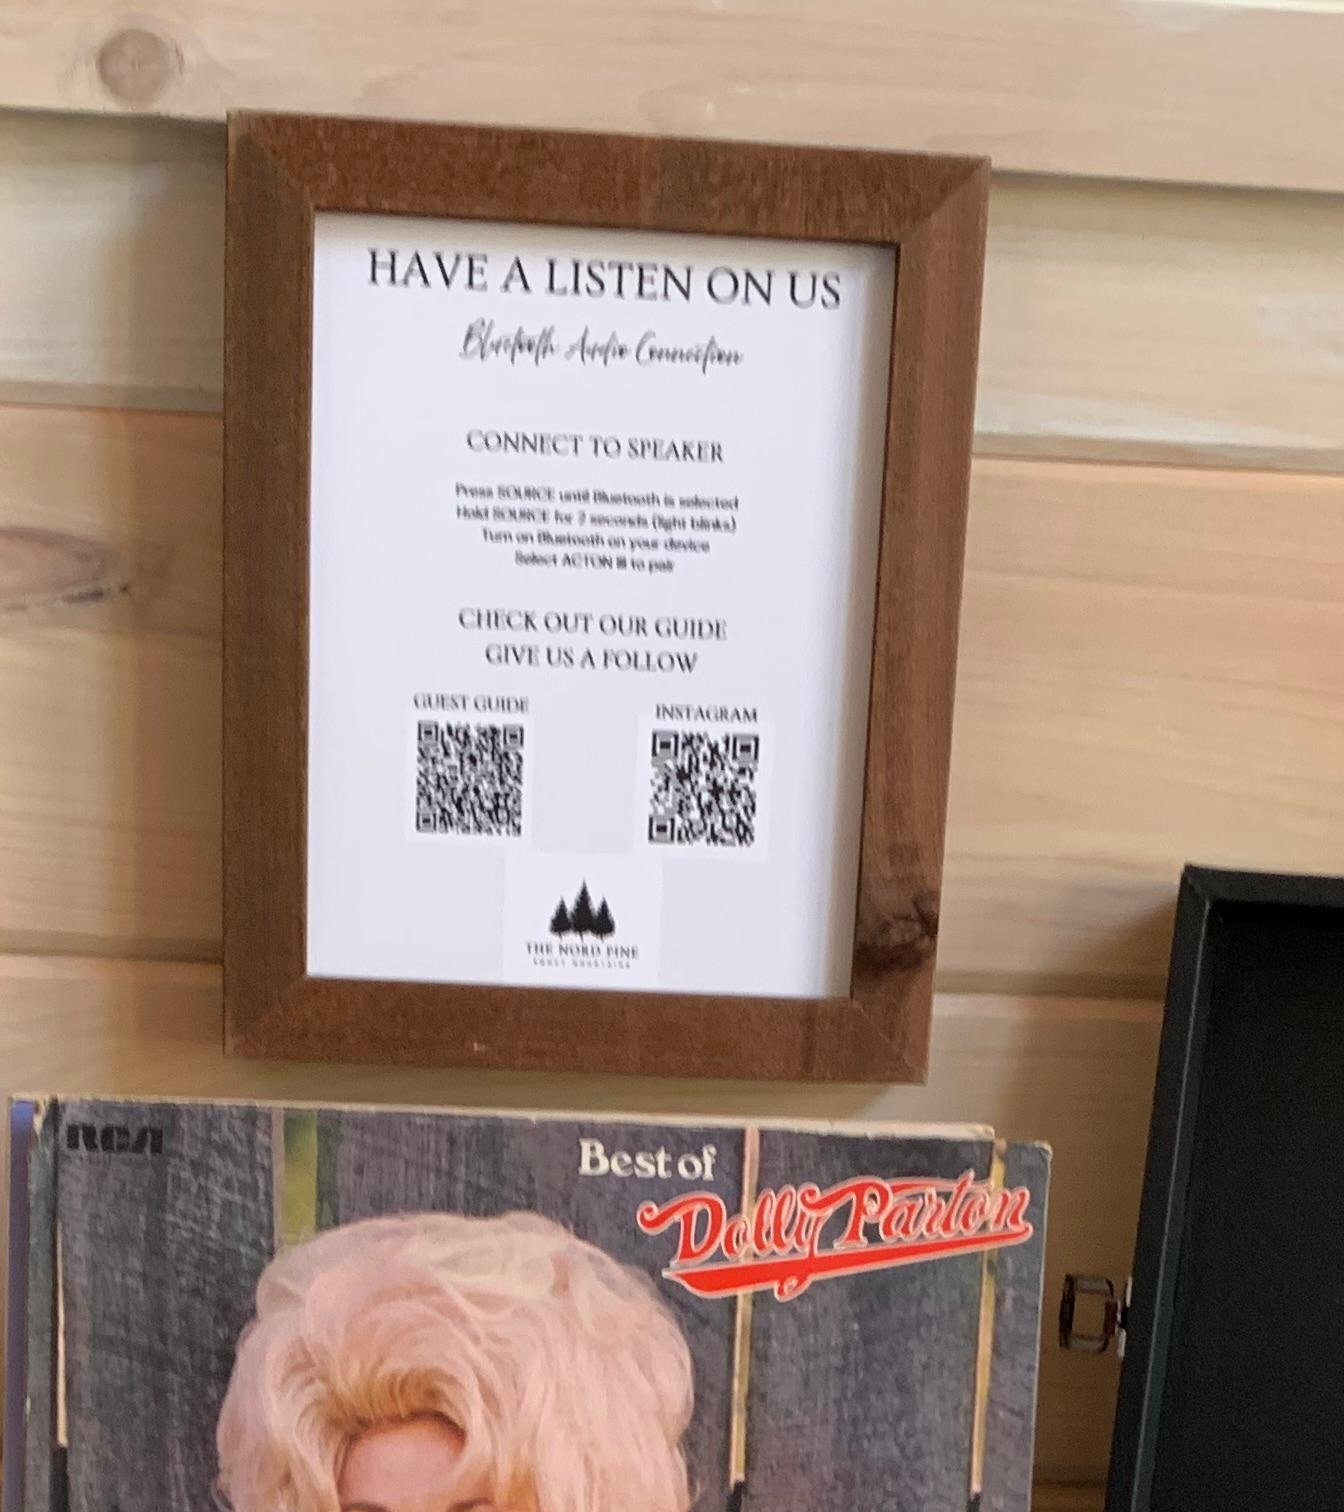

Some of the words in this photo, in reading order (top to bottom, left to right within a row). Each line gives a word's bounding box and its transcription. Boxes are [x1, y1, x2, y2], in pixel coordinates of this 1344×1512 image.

[367, 247, 488, 291] HAVE
[499, 255, 531, 293] A
[544, 256, 692, 302] LISTEN
[706, 265, 773, 306] ON
[788, 270, 842, 310] US
[458, 316, 556, 368] Bluetooth
[563, 324, 632, 367] Audio
[635, 328, 743, 376] Connection
[466, 427, 583, 457] CONNECT
[588, 433, 621, 459] TO
[627, 436, 724, 464] SPEAKER
[455, 481, 494, 499] Press
[497, 484, 554, 502] SOURCE
[559, 487, 590, 503] until
[593, 488, 660, 507] Bluetooth
[663, 492, 675, 508] is
[679, 493, 739, 511] selected
[456, 504, 489, 520] Hold
[493, 506, 550, 524] SOURCE
[554, 509, 572, 525] for
[590, 513, 648, 529] seconds
[652, 513, 686, 533] (light
[690, 515, 736, 534] blinks)
[483, 527, 513, 543] Turn
[515, 531, 534, 544] on
[537, 529, 605, 548] Bluetooth
[607, 535, 626, 550] on
[629, 537, 659, 552] your
[663, 537, 710, 553] device
[514, 549, 557, 567] Select
[562, 552, 613, 570] ACTON
[630, 557, 645, 572] to
[647, 556, 674, 575] pair
[458, 606, 538, 633] CHECK
[544, 610, 594, 636] OUT
[599, 612, 649, 638] OUR
[655, 616, 727, 641] GUIDE
[485, 643, 540, 668] GIVE
[546, 646, 575, 669] US
[579, 648, 597, 671] A
[602, 649, 699, 674] FOLLOW
[413, 691, 470, 713] GUEST
[473, 694, 530, 715] GUIDE
[655, 702, 759, 725] INSTAGRAM
[526, 941, 554, 956] THE
[558, 942, 602, 958] NORD
[605, 943, 639, 960] PINE
[66, 1122, 164, 1154] RCA
[577, 1137, 673, 1180] Best
[677, 1143, 719, 1182] of
[636, 1182, 832, 1268] Dolly
[800, 1168, 1032, 1250] Parton
